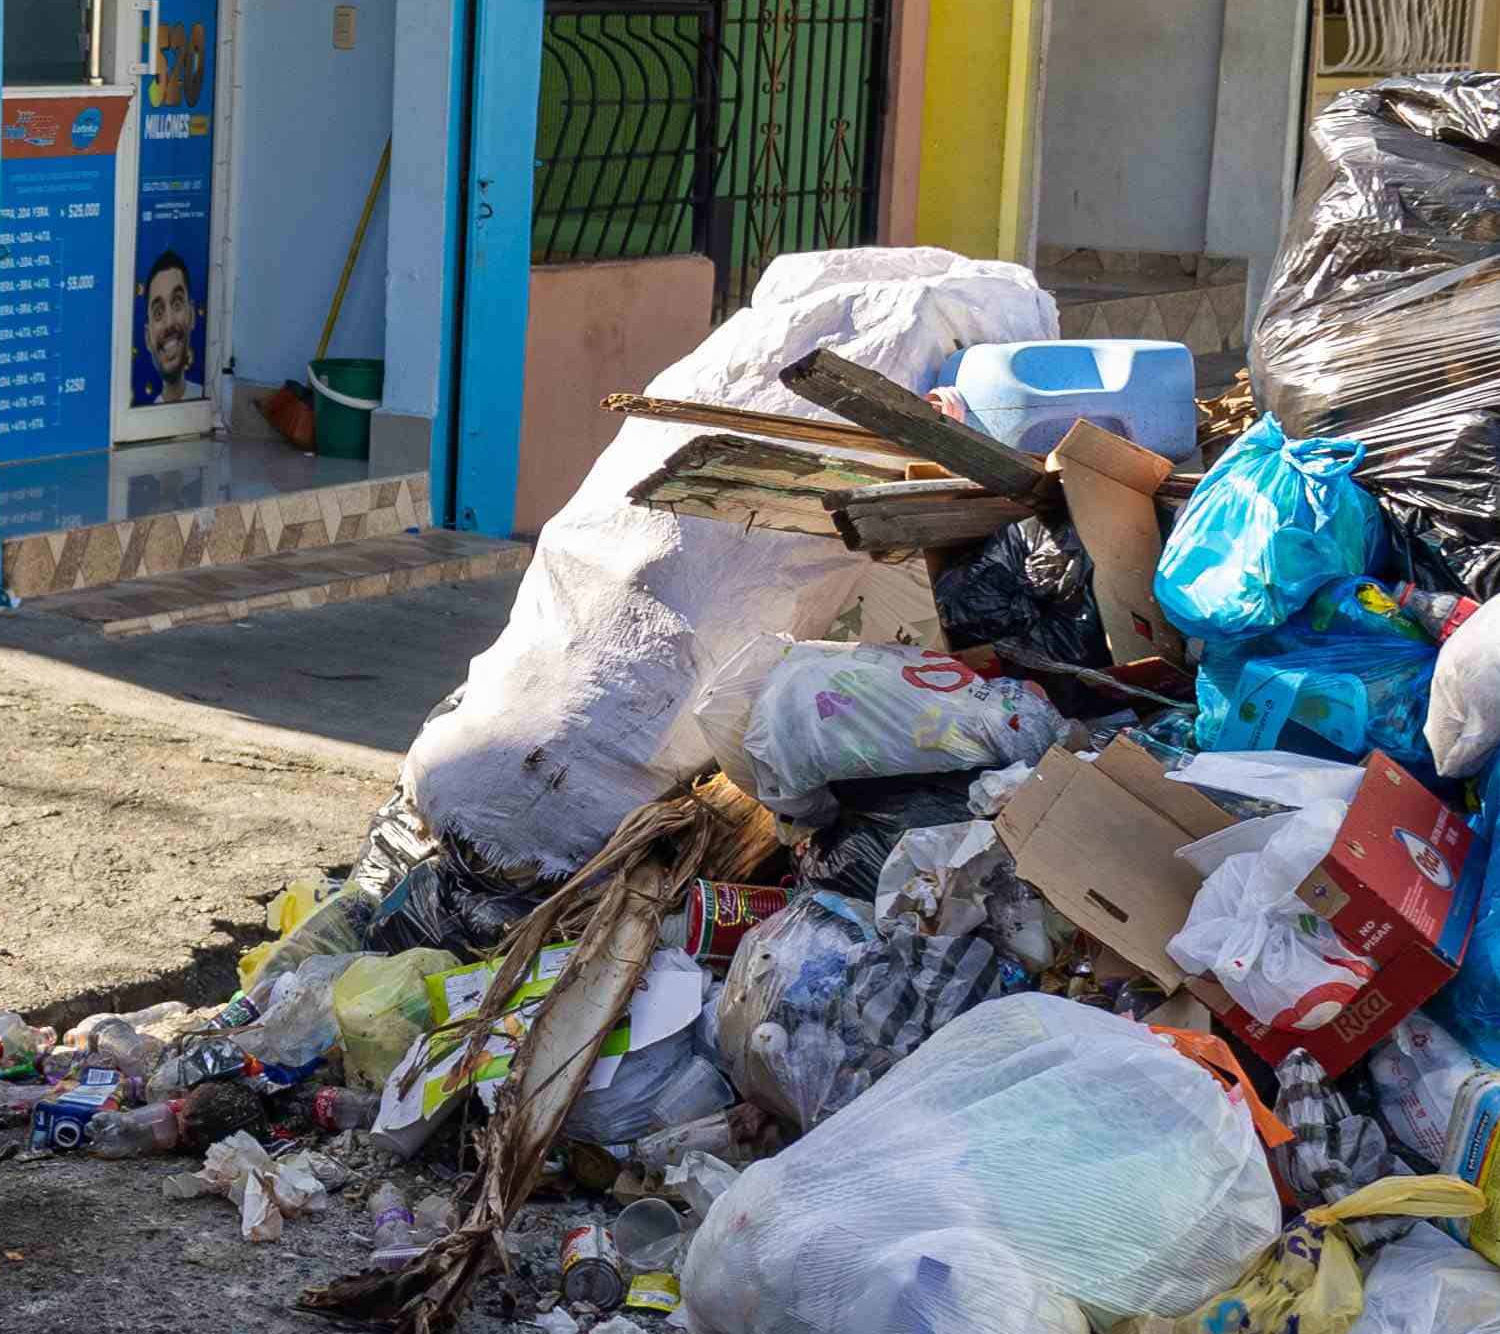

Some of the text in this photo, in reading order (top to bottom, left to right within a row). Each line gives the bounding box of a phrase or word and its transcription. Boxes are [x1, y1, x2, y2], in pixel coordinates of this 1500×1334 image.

[144, 113, 190, 139] MILLONES
[1414, 845, 1442, 877] Rica
[1358, 919, 1377, 938] NO
[1361, 921, 1394, 952] PISAR
[1331, 987, 1394, 1044] Rica
